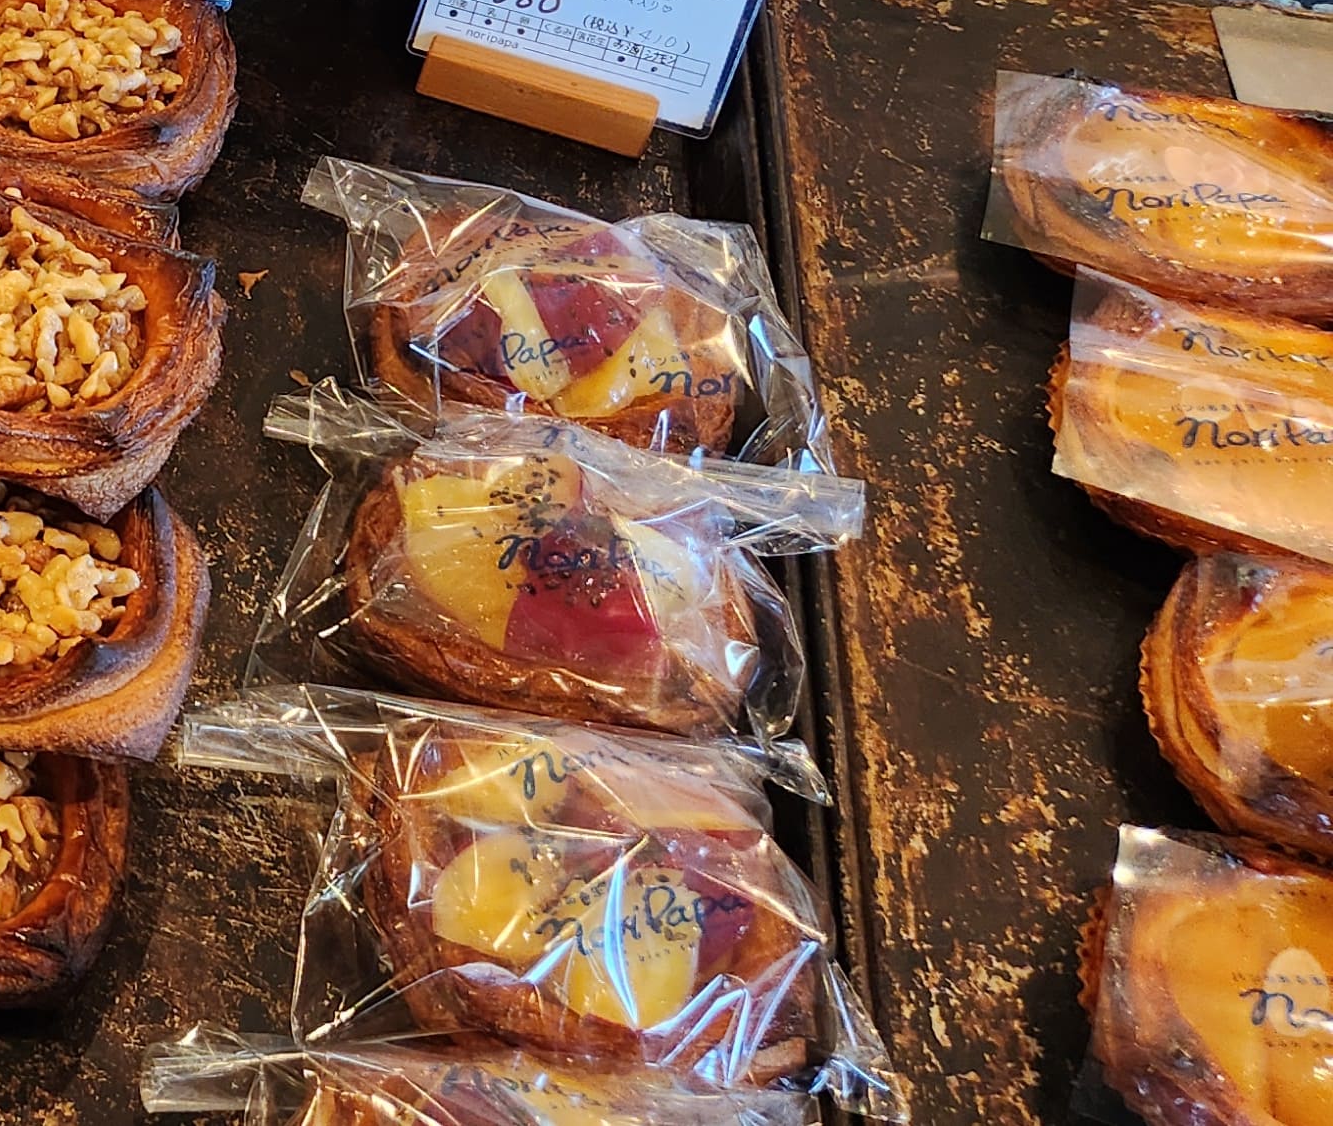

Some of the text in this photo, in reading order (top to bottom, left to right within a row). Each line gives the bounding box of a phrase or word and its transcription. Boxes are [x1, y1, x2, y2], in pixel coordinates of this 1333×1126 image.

[465, 29, 519, 49] noripapa
[543, 22, 573, 38] くるみ
